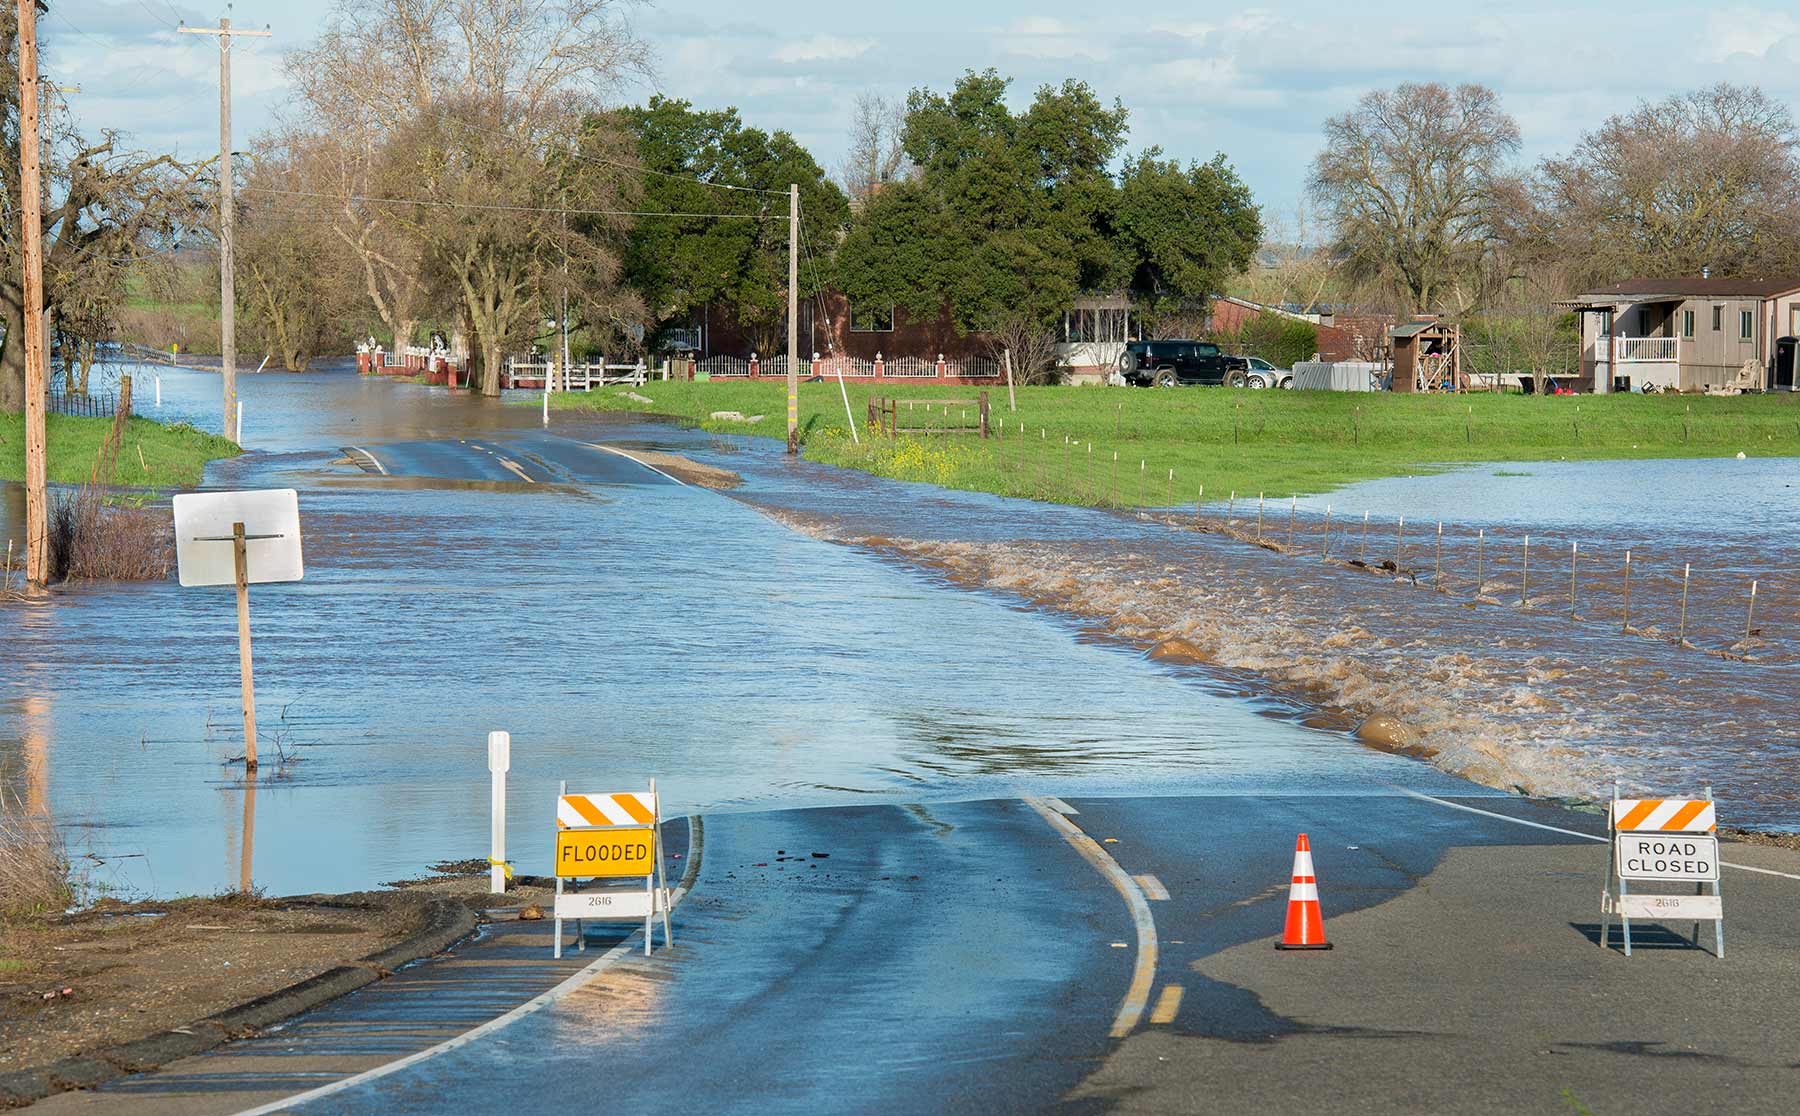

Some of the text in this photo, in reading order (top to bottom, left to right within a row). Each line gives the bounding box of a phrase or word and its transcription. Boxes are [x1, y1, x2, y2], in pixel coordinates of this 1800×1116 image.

[562, 844, 647, 862] FLOODED
[1638, 842, 1696, 856] ROAD
[1627, 859, 1709, 873] CLOSED
